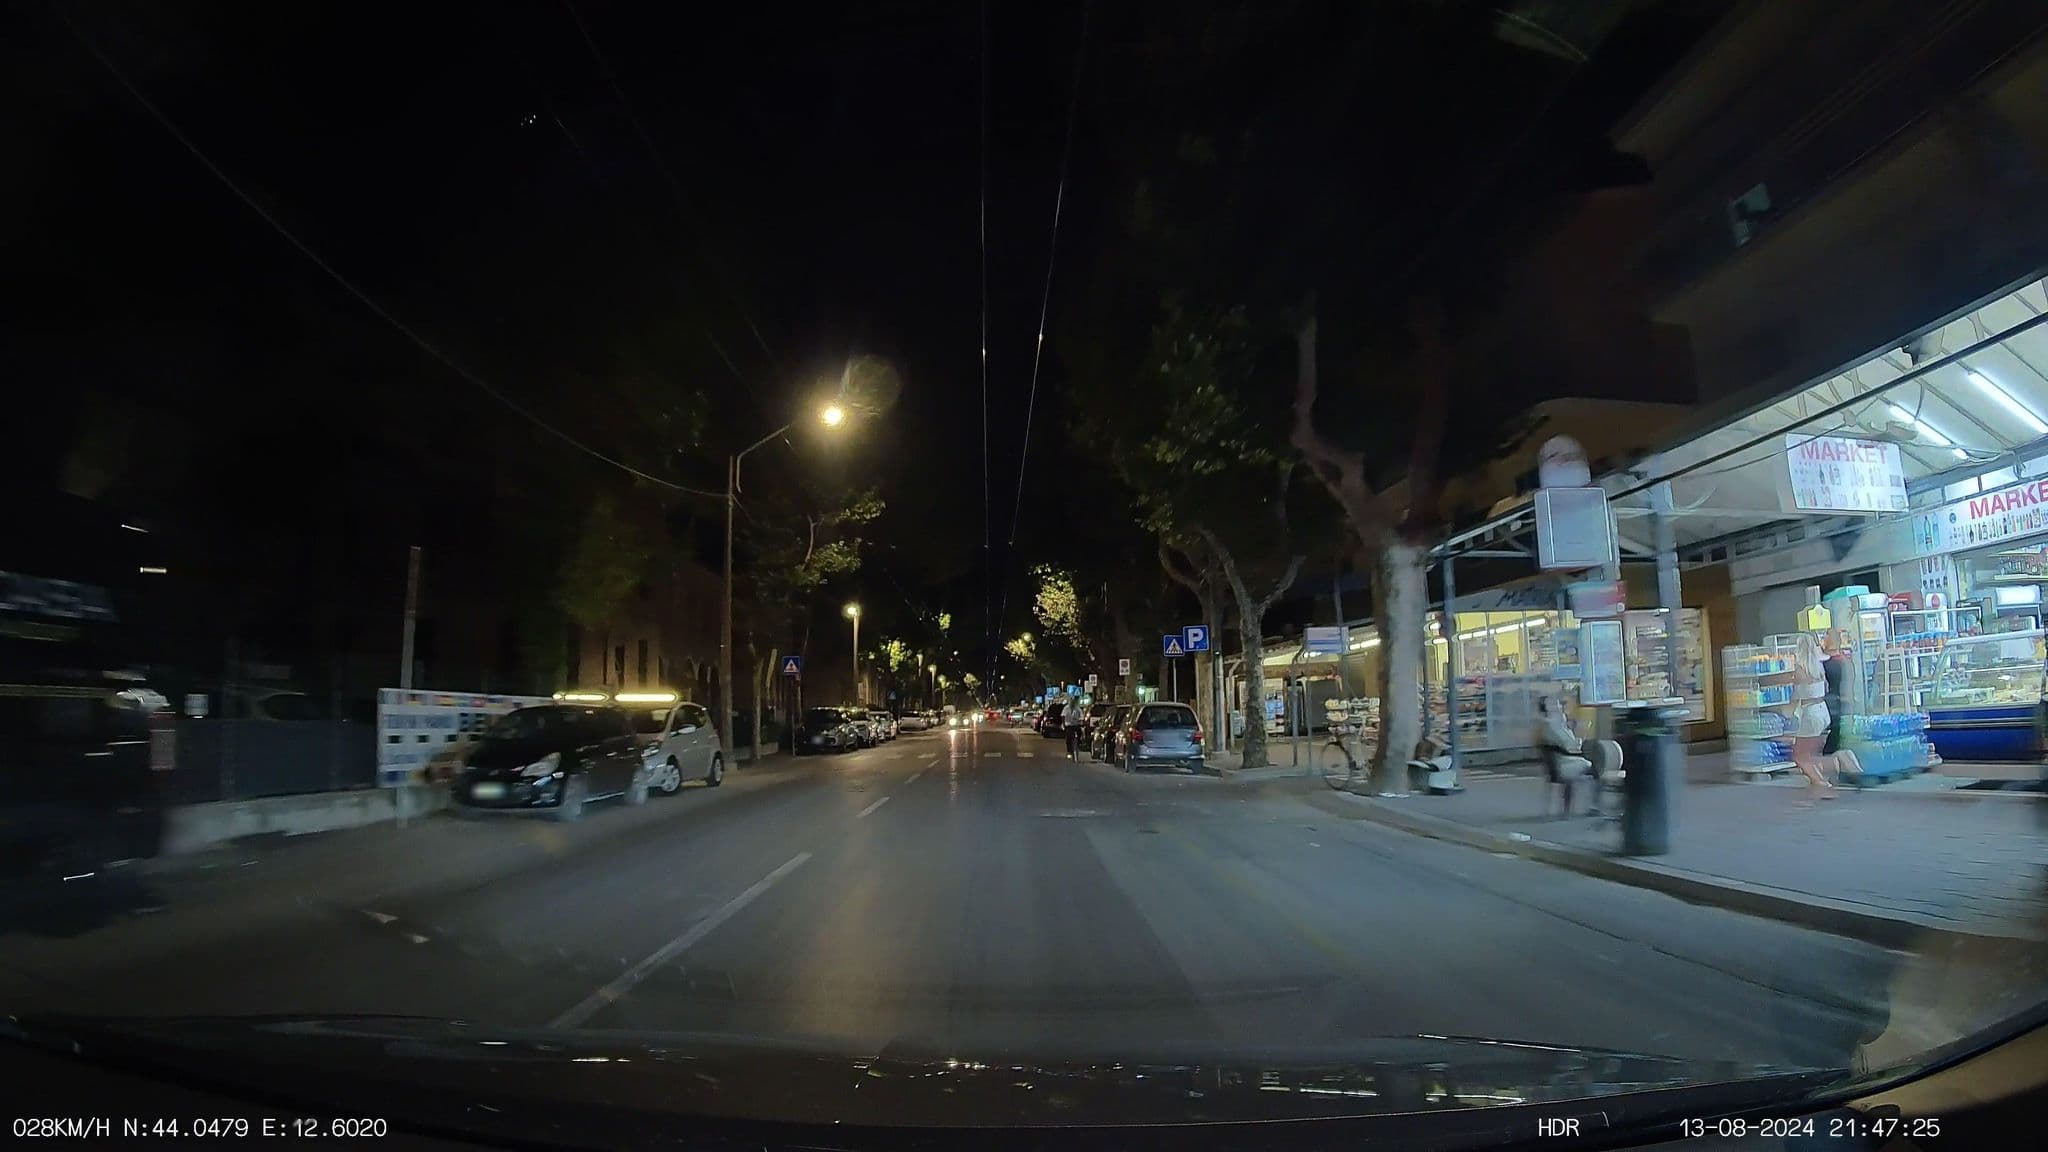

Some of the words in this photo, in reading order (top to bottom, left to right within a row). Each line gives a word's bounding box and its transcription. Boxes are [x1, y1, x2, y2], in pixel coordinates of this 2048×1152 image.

[1801, 439, 1888, 465] MARKET
[1969, 480, 2048, 520] MARKE
[1188, 628, 1204, 649] P
